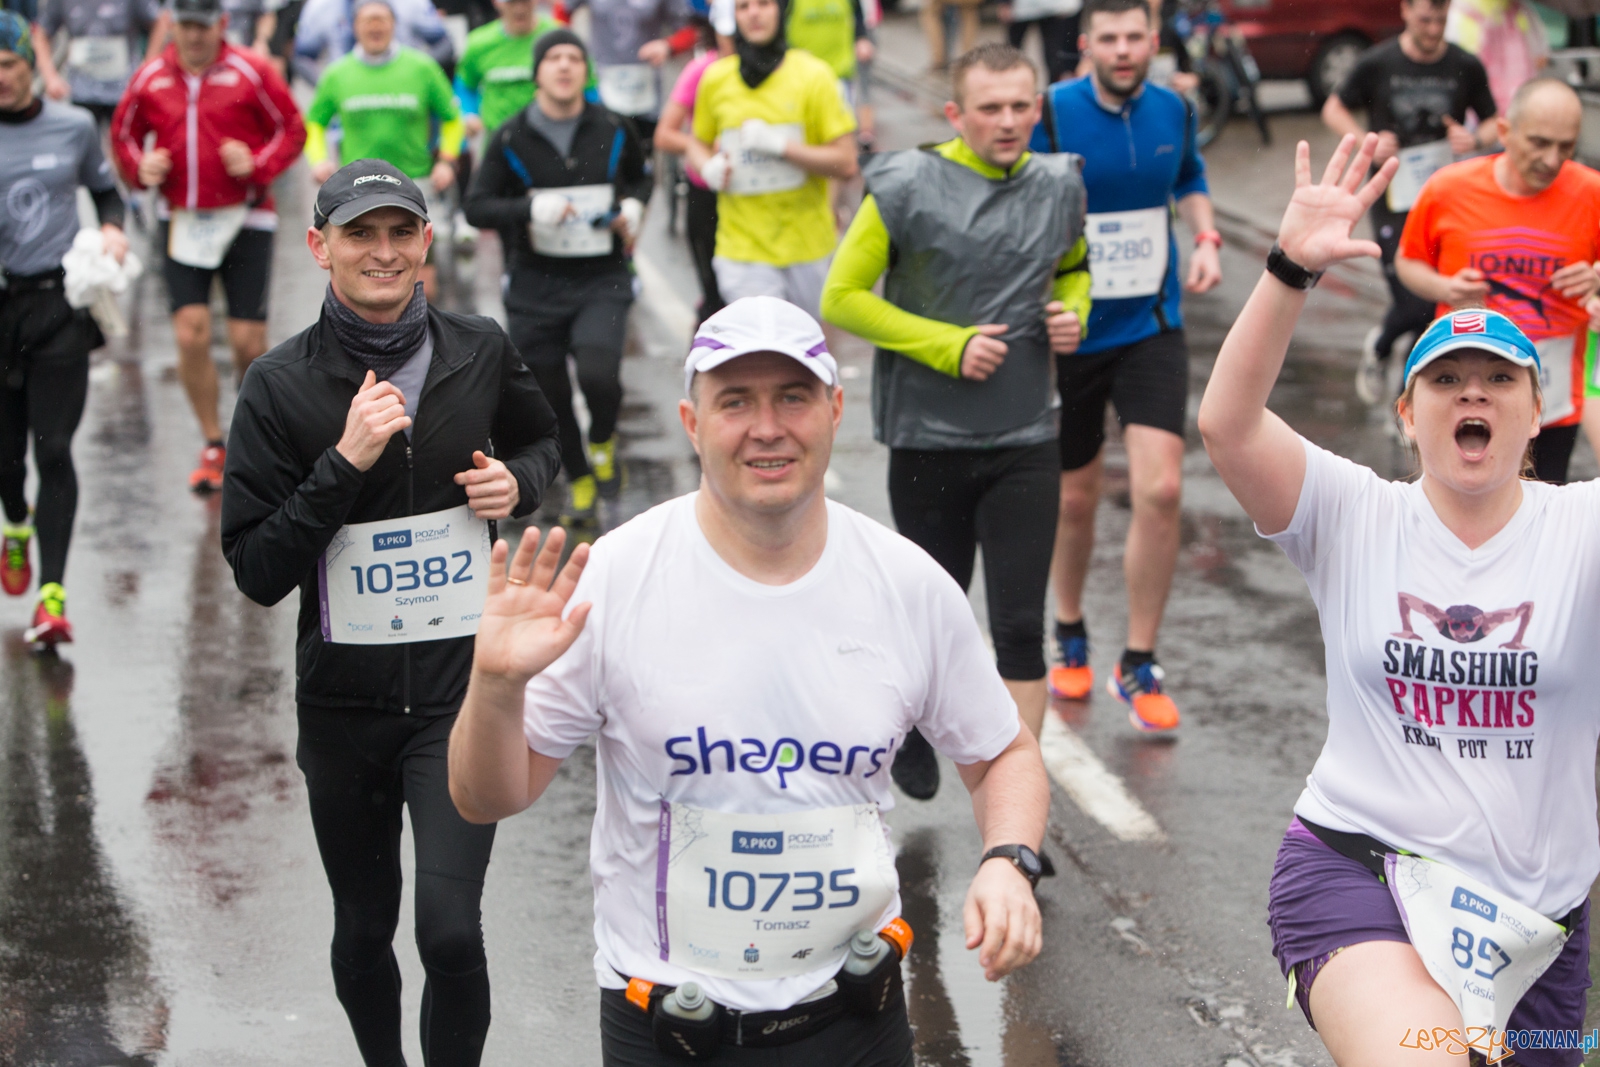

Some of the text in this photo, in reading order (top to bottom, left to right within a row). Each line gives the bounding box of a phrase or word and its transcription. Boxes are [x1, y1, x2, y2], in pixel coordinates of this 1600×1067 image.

[1087, 236, 1154, 263] 9280
[351, 550, 473, 594] 10382
[395, 595, 439, 606] Szymon
[1383, 639, 1538, 687] SMASHING
[1385, 677, 1536, 728] PAPKINS
[1457, 738, 1487, 759] POT
[704, 867, 860, 912] 10735
[753, 919, 810, 931] Tomasz
[1463, 979, 1495, 1001] Kasia
